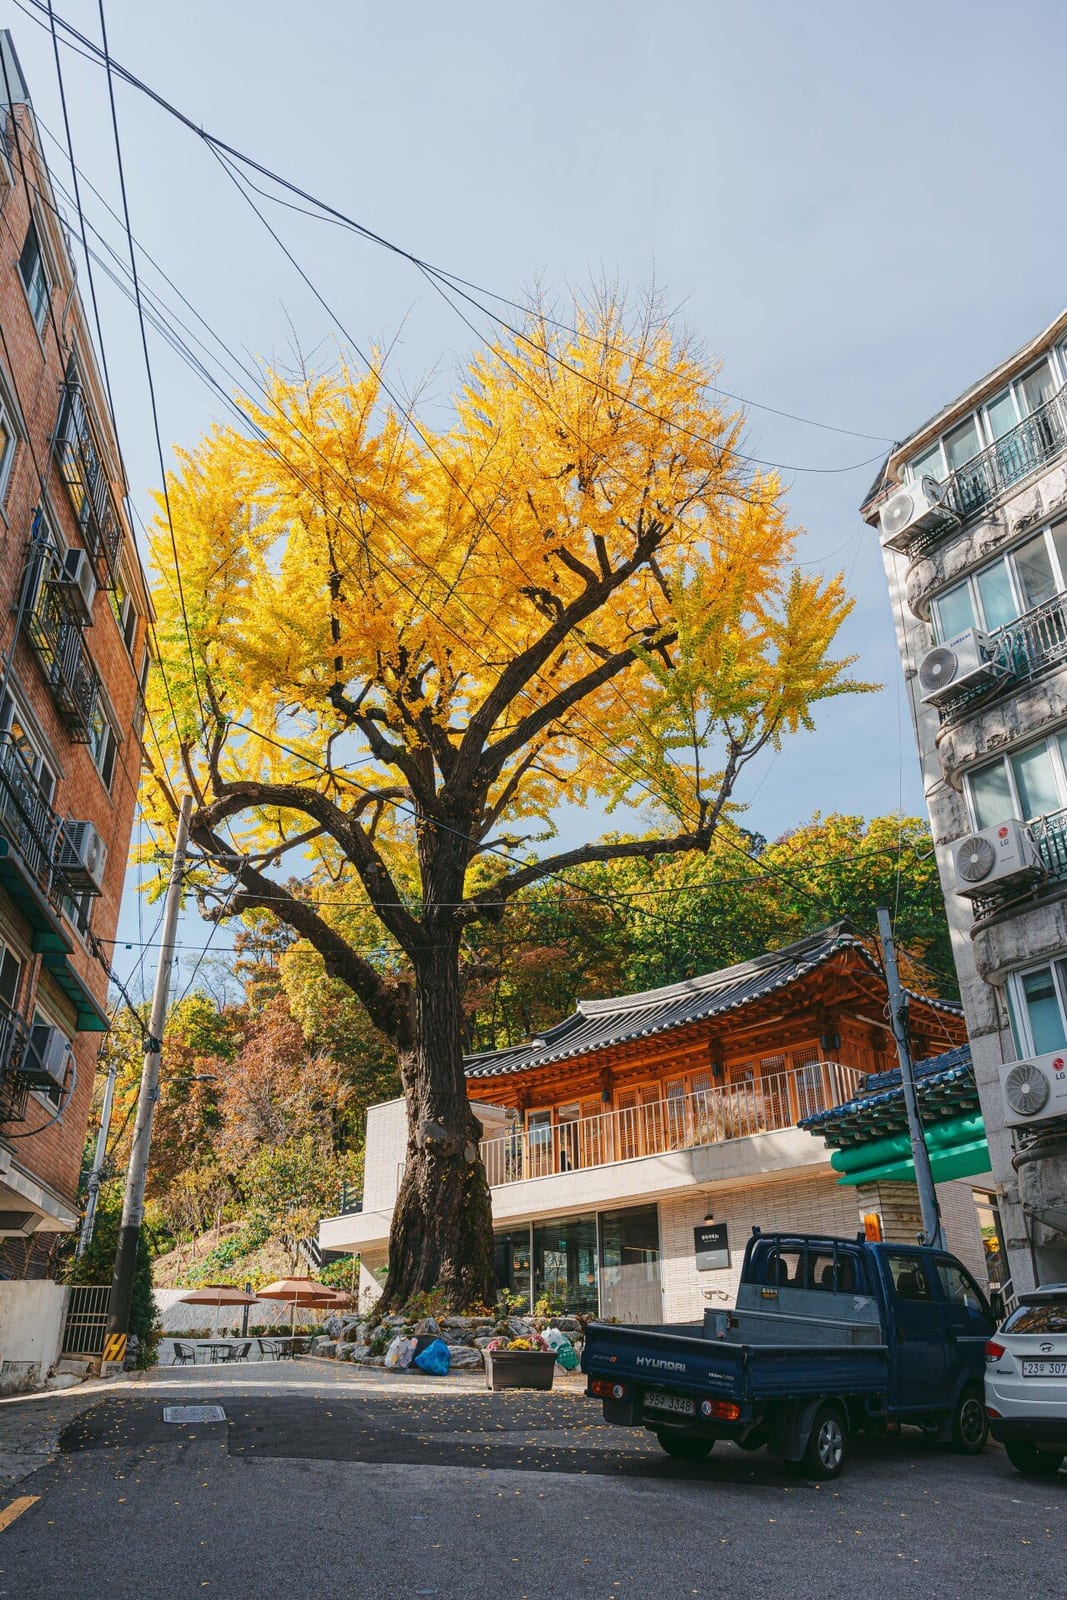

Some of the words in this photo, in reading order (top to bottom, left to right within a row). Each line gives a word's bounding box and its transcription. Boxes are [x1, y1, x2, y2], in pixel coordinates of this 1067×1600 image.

[1000, 839, 1009, 847] LG
[1055, 1072, 1066, 1080] LG
[636, 1356, 686, 1372] HYUNDAI
[668, 1398, 691, 1412] 3348
